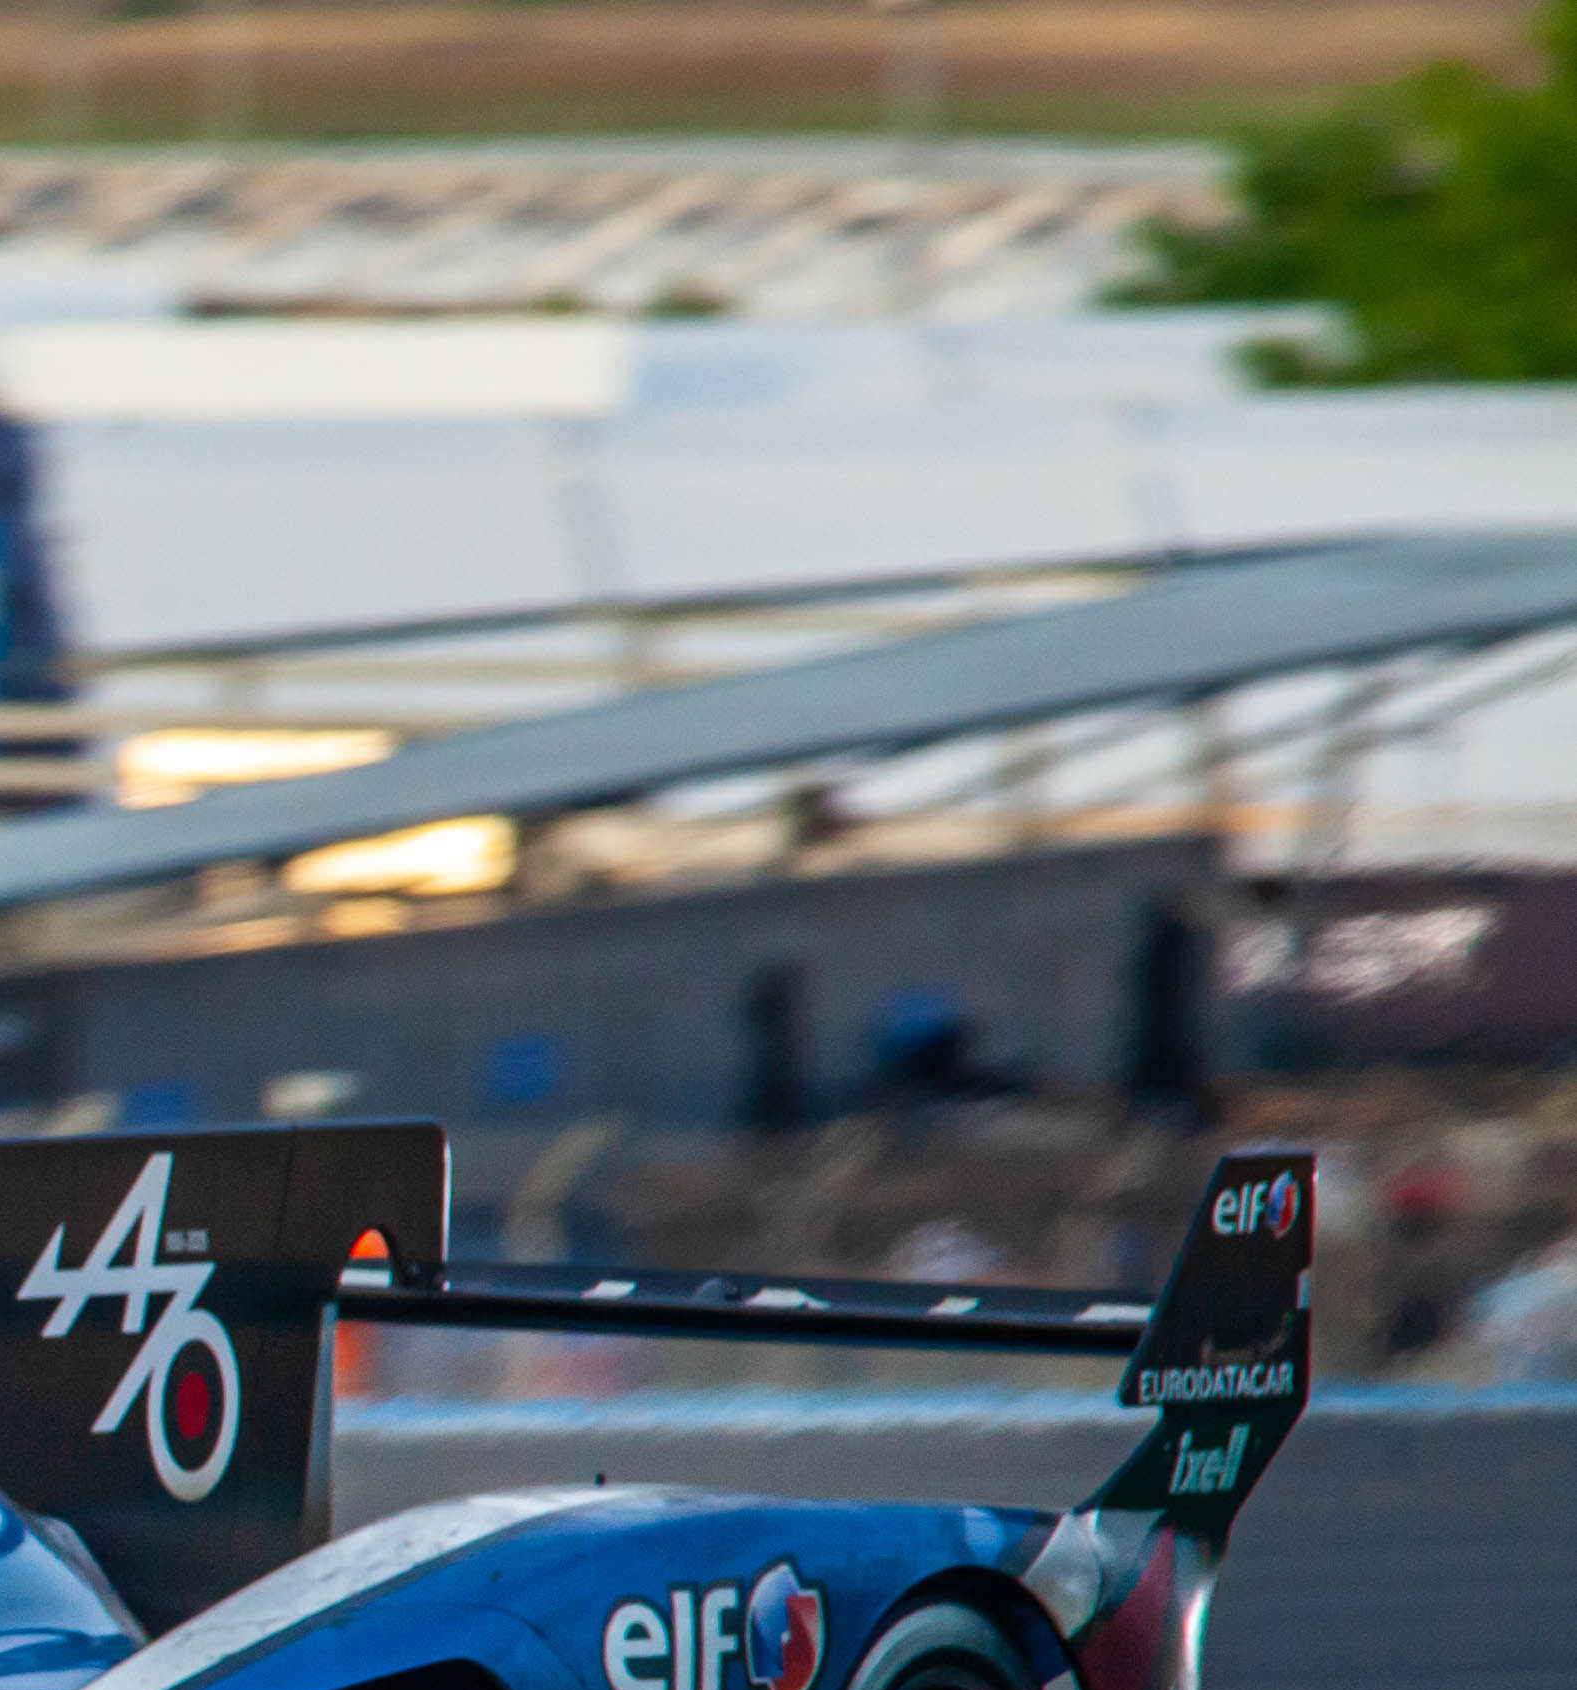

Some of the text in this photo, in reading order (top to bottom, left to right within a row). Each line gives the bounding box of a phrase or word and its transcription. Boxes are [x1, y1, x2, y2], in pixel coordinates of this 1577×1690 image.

[1211, 1181, 1269, 1235] elf
[1137, 1362, 1294, 1404] EURODATACAR
[1168, 1424, 1250, 1495] ixell
